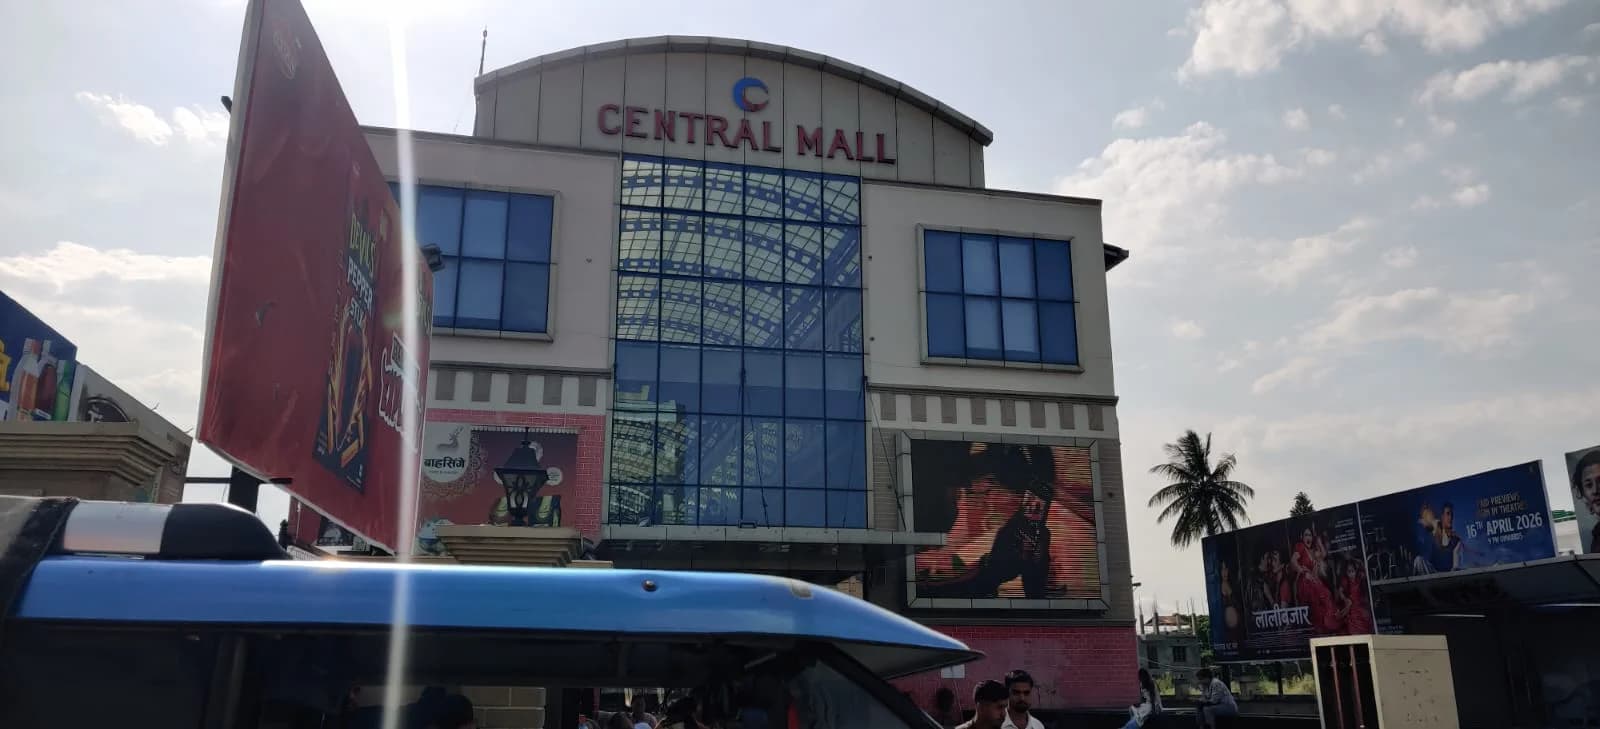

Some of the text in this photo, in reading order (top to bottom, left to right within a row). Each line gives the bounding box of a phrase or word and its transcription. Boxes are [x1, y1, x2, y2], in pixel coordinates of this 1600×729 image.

[597, 103, 897, 165] CENTRAL MALL
[347, 256, 374, 319] PEPPER
[1486, 516, 1514, 536] APRIL
[1516, 512, 1543, 530] 2026
